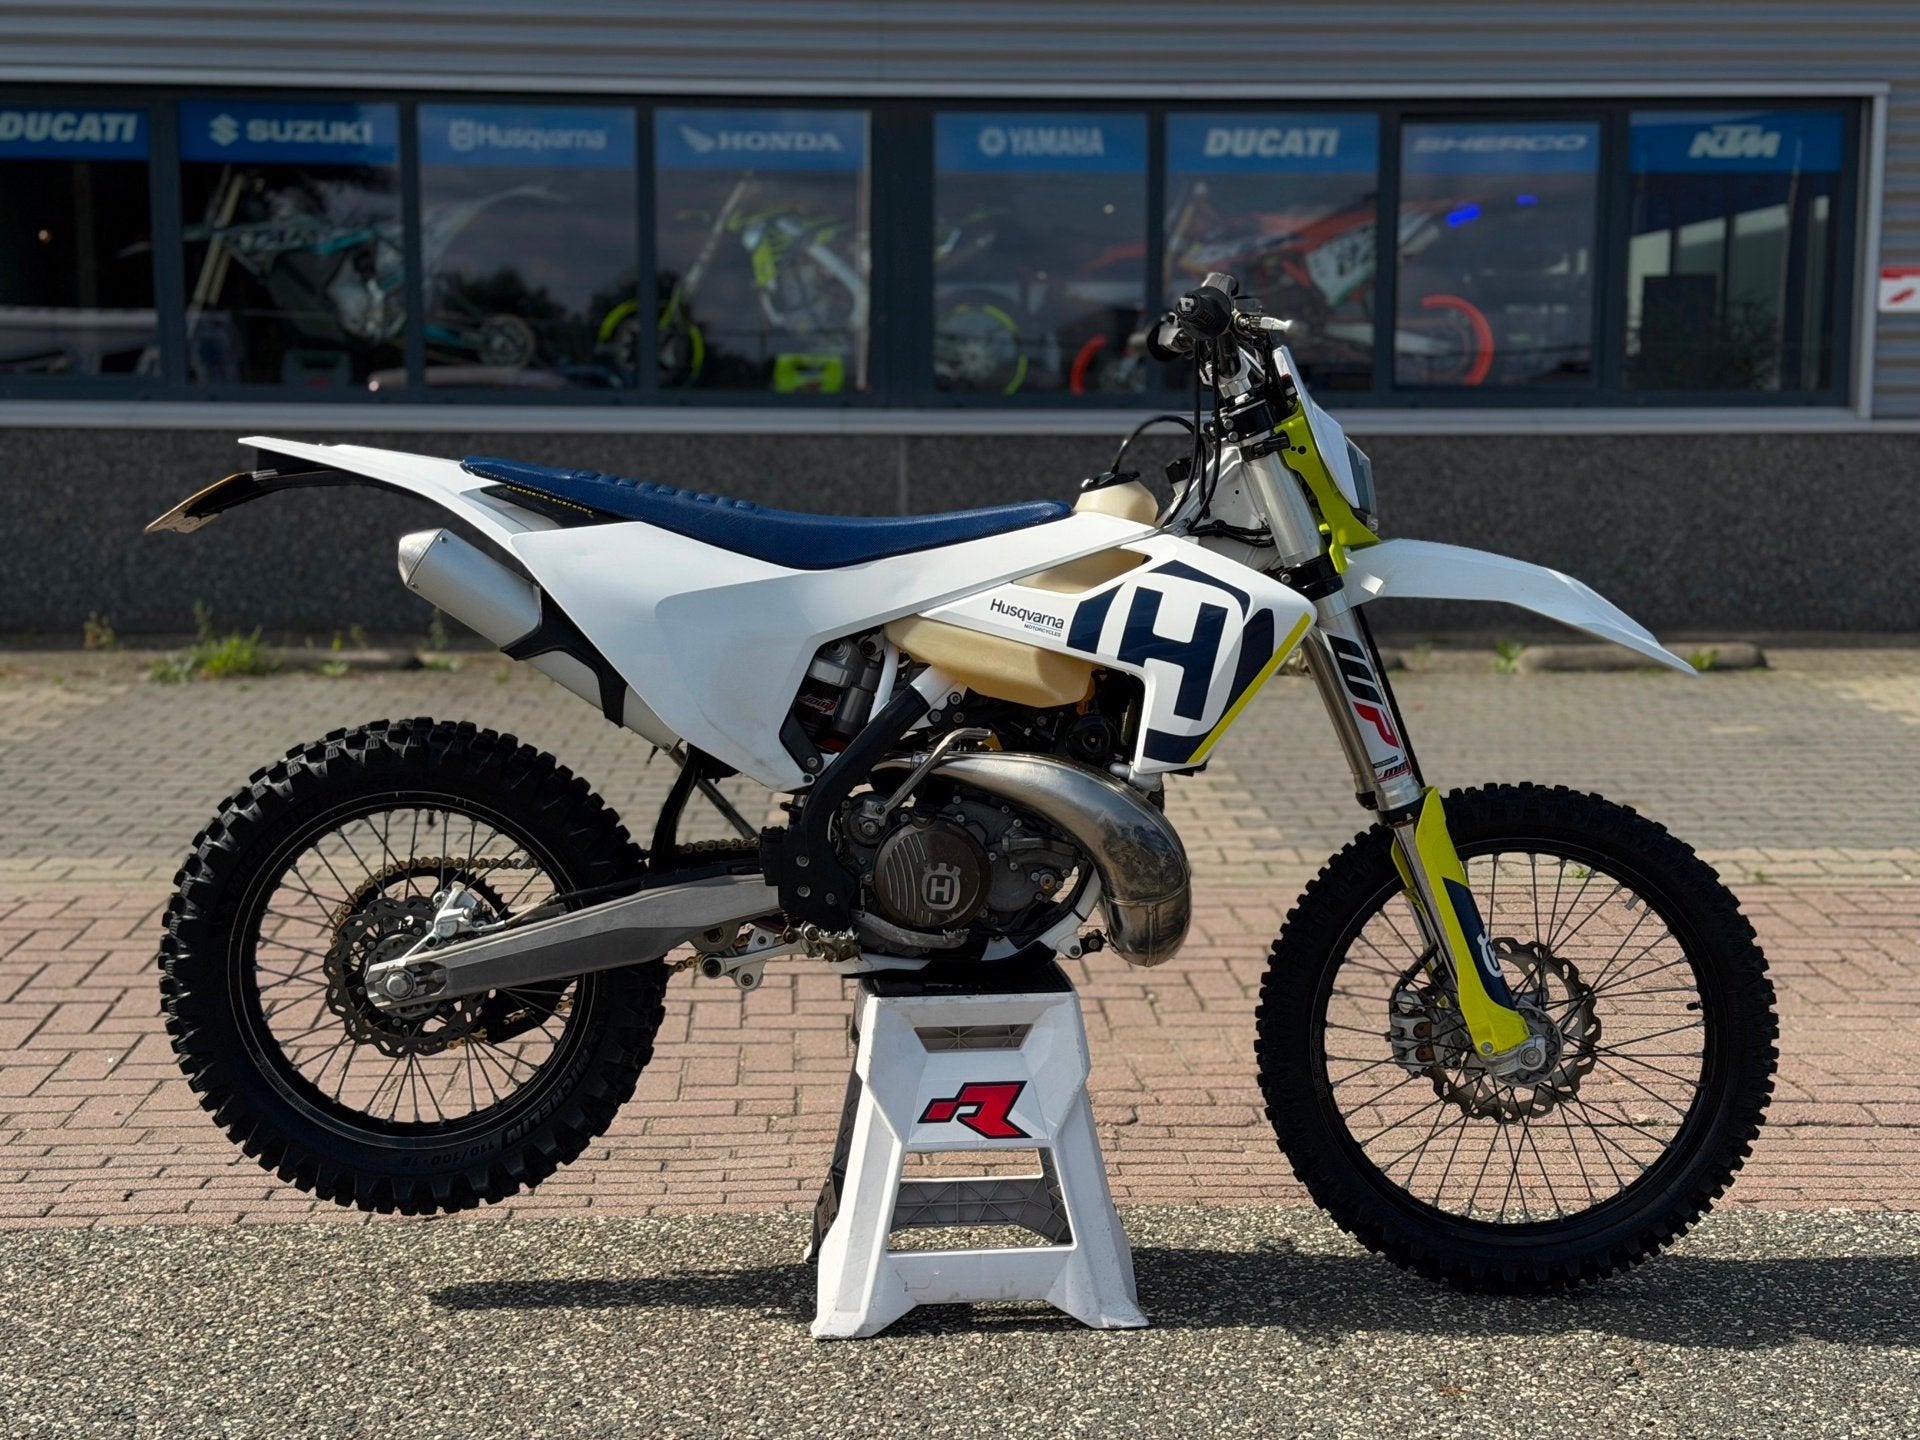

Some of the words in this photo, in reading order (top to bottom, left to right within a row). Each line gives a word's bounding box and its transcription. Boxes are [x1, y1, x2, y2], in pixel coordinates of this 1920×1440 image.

[0, 112, 138, 142] DUCATI
[246, 119, 374, 144] SUZUKI
[477, 122, 607, 151] Husqvarna
[718, 130, 843, 151] HONDA
[1009, 126, 1105, 156] YAMAHA
[1204, 127, 1341, 157] DUCATI
[1687, 124, 1782, 158] KTM
[1413, 134, 1589, 153] SHERCO
[990, 598, 1064, 629] Husqvarna
[1024, 623, 1062, 638] MOTORCYCLES
[505, 1048, 592, 1146] MICHELIN
